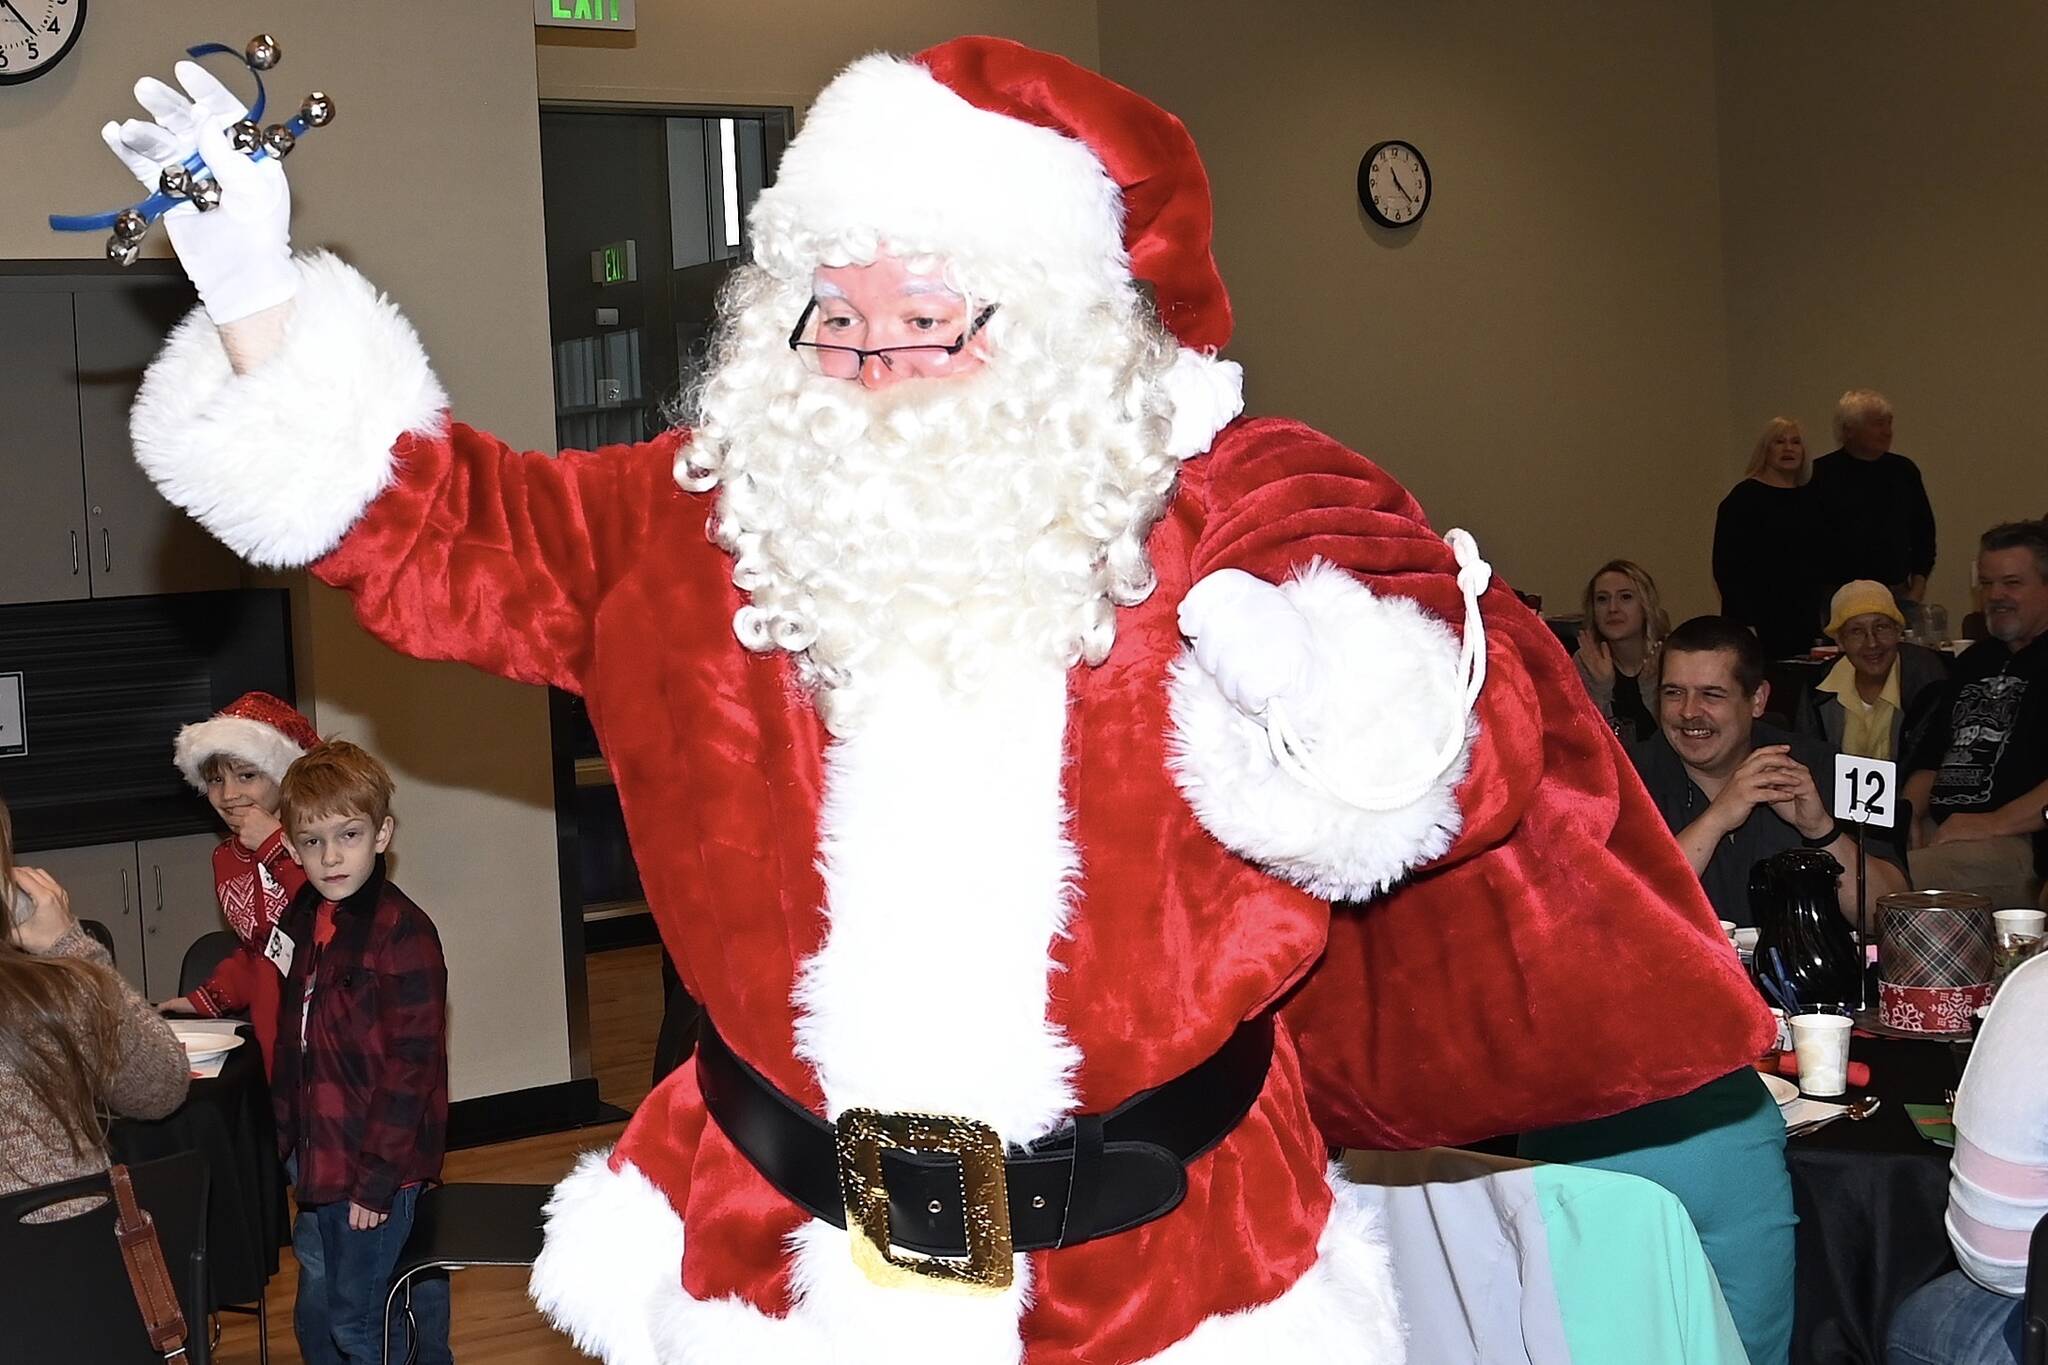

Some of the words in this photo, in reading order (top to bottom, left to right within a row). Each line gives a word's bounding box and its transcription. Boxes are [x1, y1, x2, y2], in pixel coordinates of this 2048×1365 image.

[47, 16, 61, 35] 4
[28, 42, 39, 60] 5
[1392, 148, 1398, 157] 12
[1395, 209, 1401, 220] 6
[1845, 768, 1885, 815] 12
